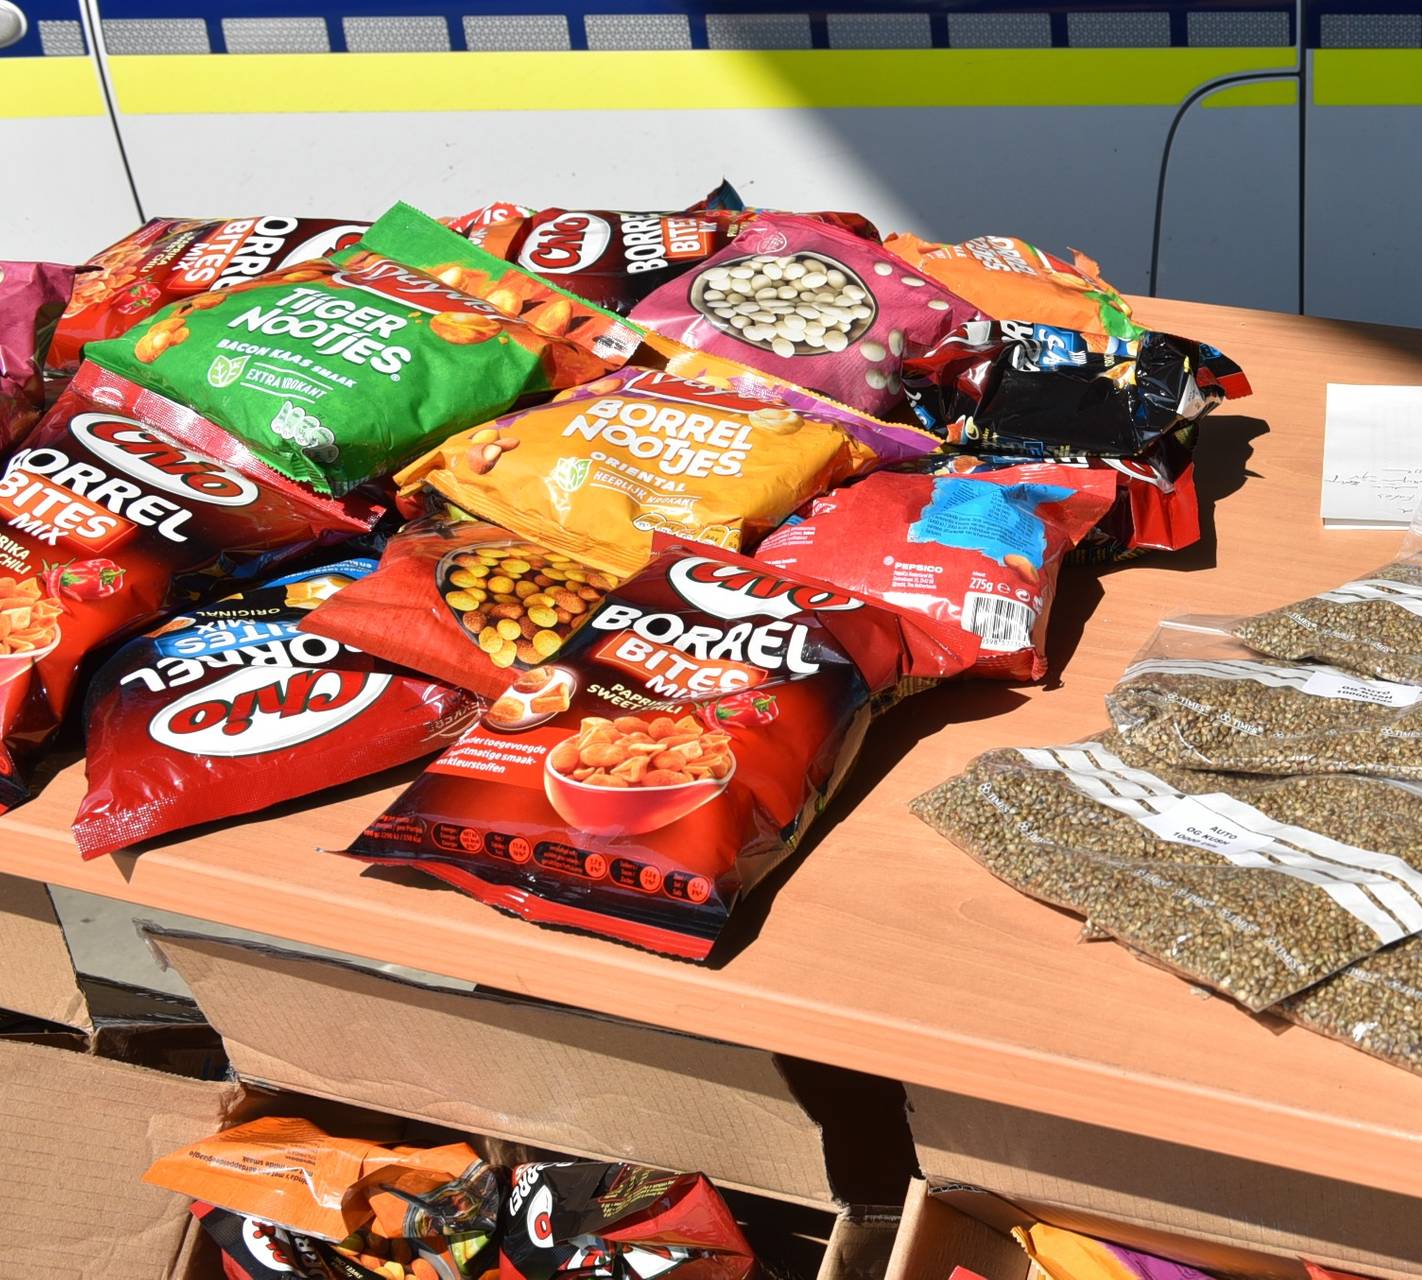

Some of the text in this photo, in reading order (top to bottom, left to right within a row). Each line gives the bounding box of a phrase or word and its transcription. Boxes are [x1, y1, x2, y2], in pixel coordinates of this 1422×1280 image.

[171, 243, 210, 271] MIX
[184, 219, 253, 283] BITES
[227, 306, 412, 375] NOOTJES
[216, 338, 358, 389] BACON KAAS SMAAK
[246, 367, 328, 400] EXTRA KROKANT
[586, 399, 753, 452] BORREL
[562, 415, 751, 478] NOOTJES
[589, 451, 687, 493] ORIENTAL
[593, 470, 647, 501] HEERLIJK
[0, 471, 118, 538] BITES
[8, 512, 70, 546] MIX
[0, 533, 31, 560] RIKA
[894, 562, 944, 574] PEPSICO
[968, 578, 994, 592] 275g
[196, 607, 280, 618] ORIGINAL
[196, 618, 257, 633] MIX
[591, 604, 821, 674] BORREL
[120, 634, 362, 693] ORREL
[615, 637, 750, 693] BITES
[586, 684, 641, 711] SWEET
[483, 736, 547, 755] toegevoegde
[502, 754, 537, 766] smaak-
[447, 758, 507, 774] kleurstoffen
[1186, 826, 1201, 836] OG
[1209, 826, 1238, 840] AUTO
